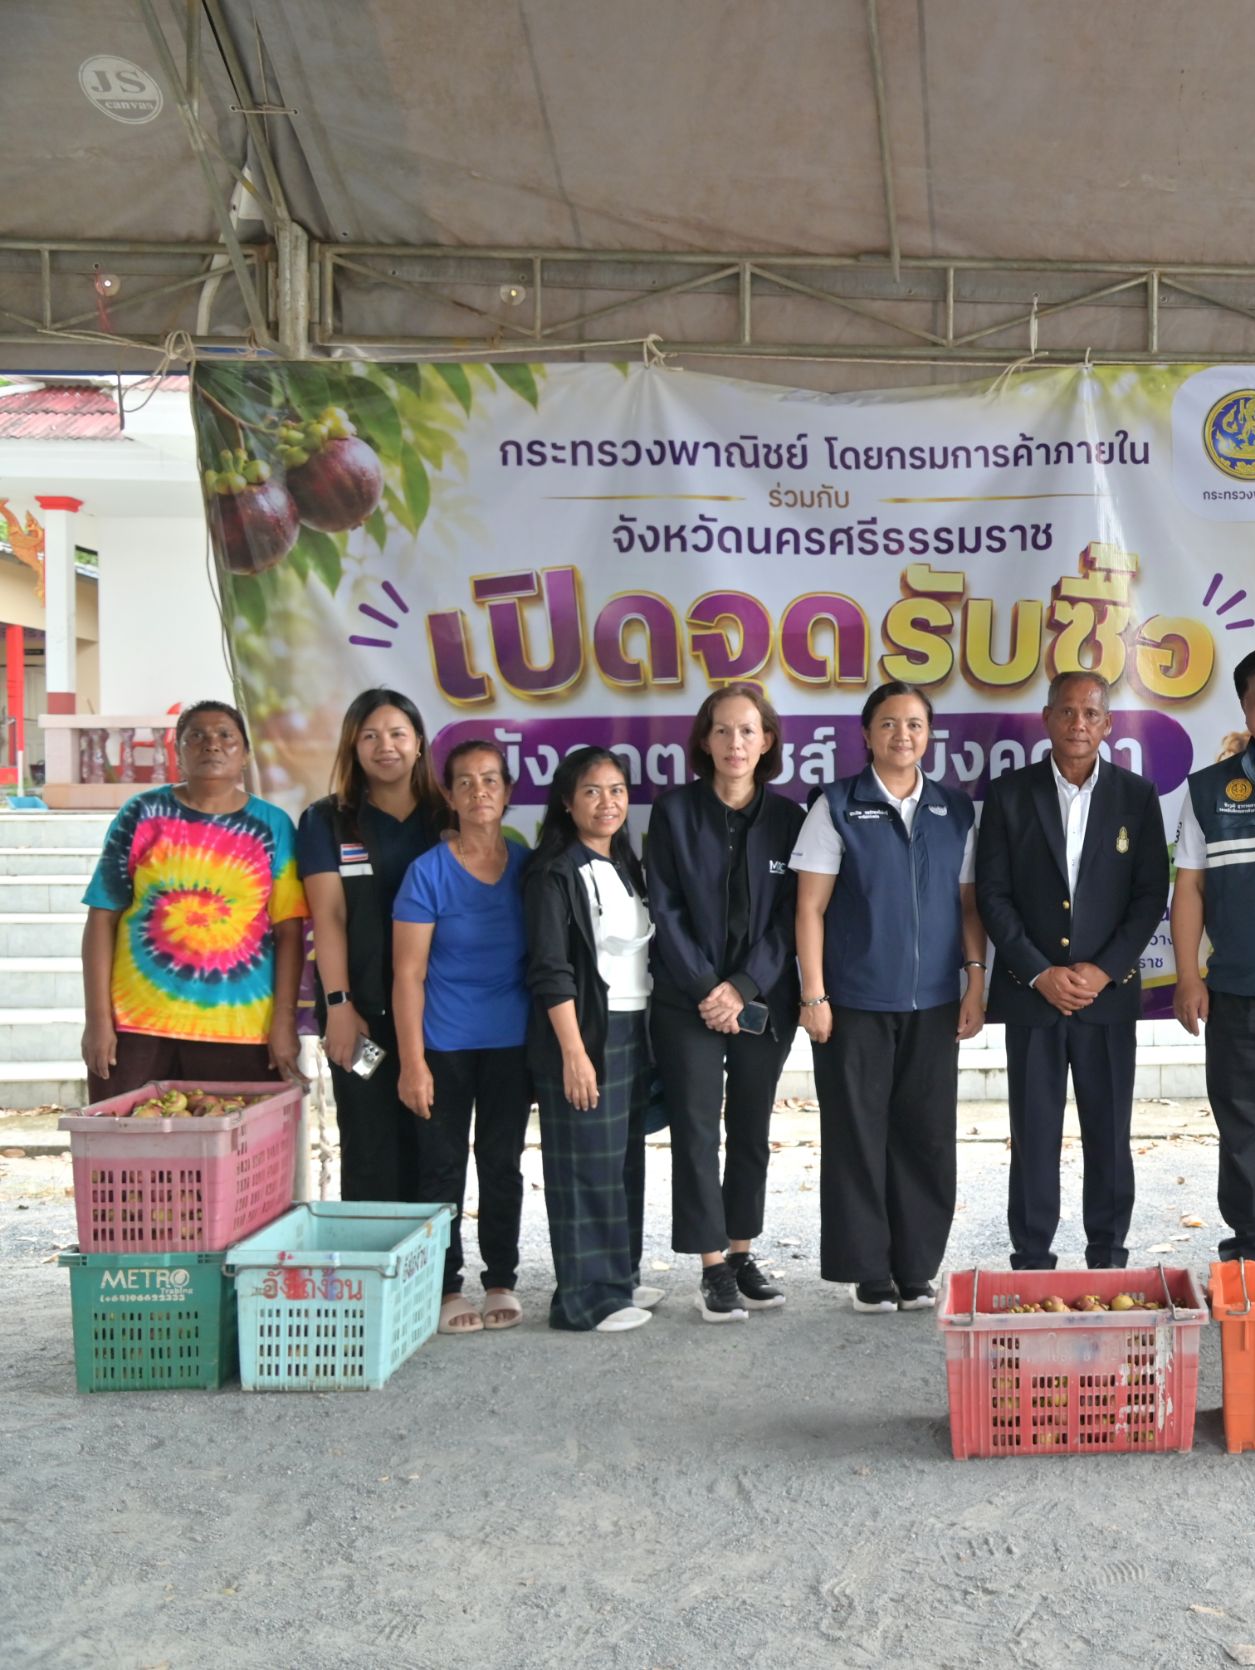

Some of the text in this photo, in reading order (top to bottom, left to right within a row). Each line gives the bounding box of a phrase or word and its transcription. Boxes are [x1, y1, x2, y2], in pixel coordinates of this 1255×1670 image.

[91, 70, 146, 93] JS
[104, 101, 153, 110] canvas
[499, 430, 1150, 470] กระทรวงพาณิชย์ โดยกรมการค้าภายใน
[769, 482, 849, 508] ร่วมกับ
[612, 514, 1053, 556] จังหวัดนครศรีธรรมราช
[101, 1269, 190, 1288] METRO
